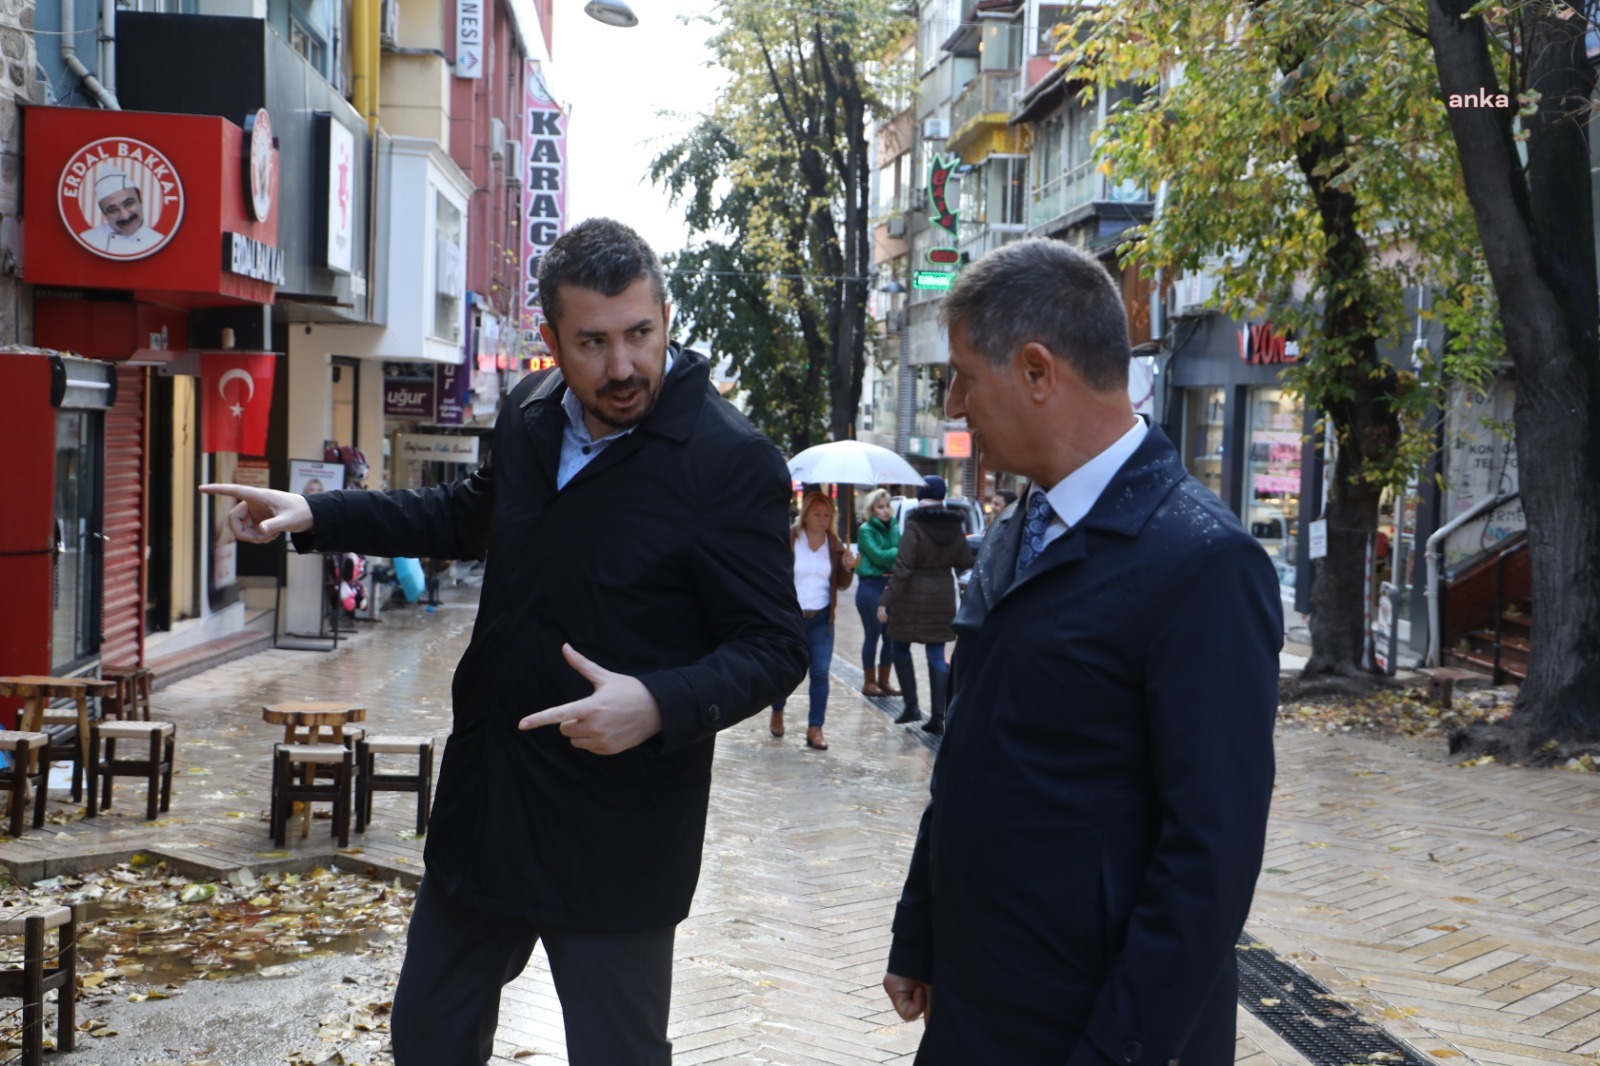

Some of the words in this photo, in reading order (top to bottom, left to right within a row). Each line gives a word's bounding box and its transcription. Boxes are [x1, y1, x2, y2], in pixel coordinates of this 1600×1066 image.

[64, 145, 109, 198] ERDAL
[118, 142, 178, 205] BAKKAL
[387, 388, 428, 407] uğur
